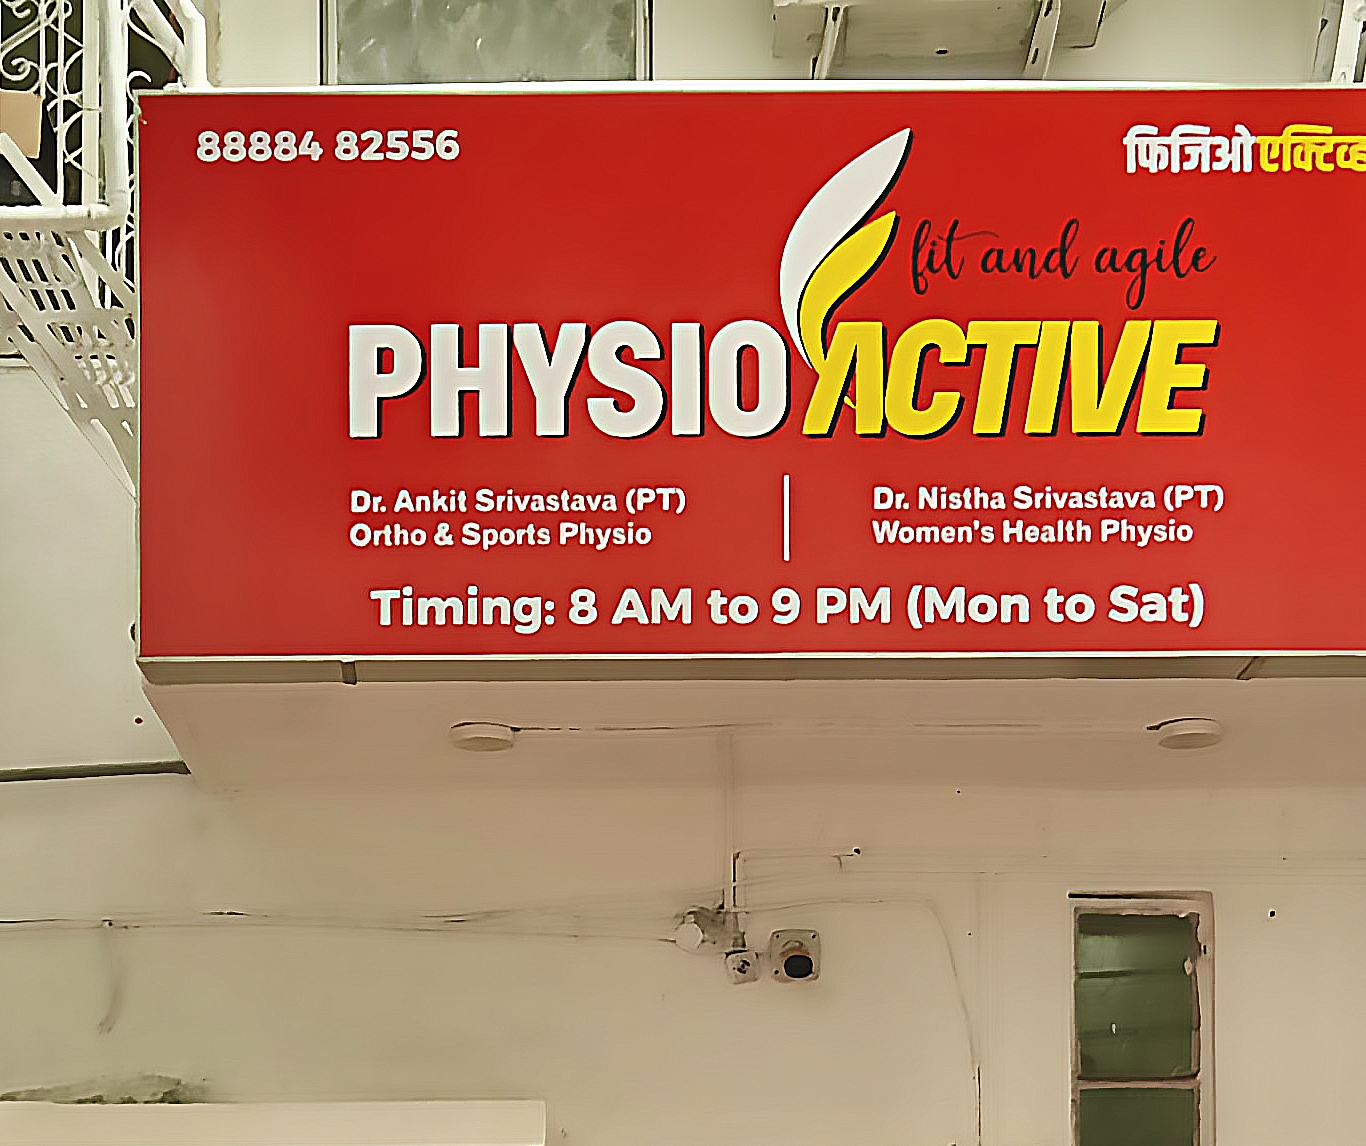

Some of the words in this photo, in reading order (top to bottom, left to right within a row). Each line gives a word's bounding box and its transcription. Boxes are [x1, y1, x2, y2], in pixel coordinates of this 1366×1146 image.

[196, 130, 323, 161] 88884
[334, 129, 460, 161] 82556
[911, 218, 998, 295] fit
[980, 218, 1079, 279] and
[1095, 217, 1217, 310] agile
[348, 320, 789, 440] PHYSIO
[802, 319, 1220, 440] ACTIVE
[351, 490, 387, 513] Dr.
[394, 489, 467, 513] Ankit
[475, 488, 617, 513] Srivastava
[625, 486, 686, 514] (PT)
[873, 487, 909, 511] Dr.
[917, 486, 1005, 511] Nistha
[1013, 485, 1155, 511] Srivastava
[1164, 484, 1224, 513] (PT)
[349, 523, 427, 547] Ortho
[433, 523, 454, 547] &
[461, 522, 550, 550] Sports
[559, 522, 652, 550] Physio
[872, 520, 994, 544] Women's
[1002, 520, 1091, 543] Health
[1100, 520, 1193, 548] Physio
[370, 585, 555, 635] Timing:
[568, 588, 598, 626] 8
[611, 588, 692, 626] AM
[707, 592, 758, 625] to
[772, 588, 800, 625] 9
[816, 587, 891, 624] PM
[907, 584, 1033, 628] (Mon
[1044, 589, 1095, 624] to
[1108, 583, 1205, 628] Sat)
